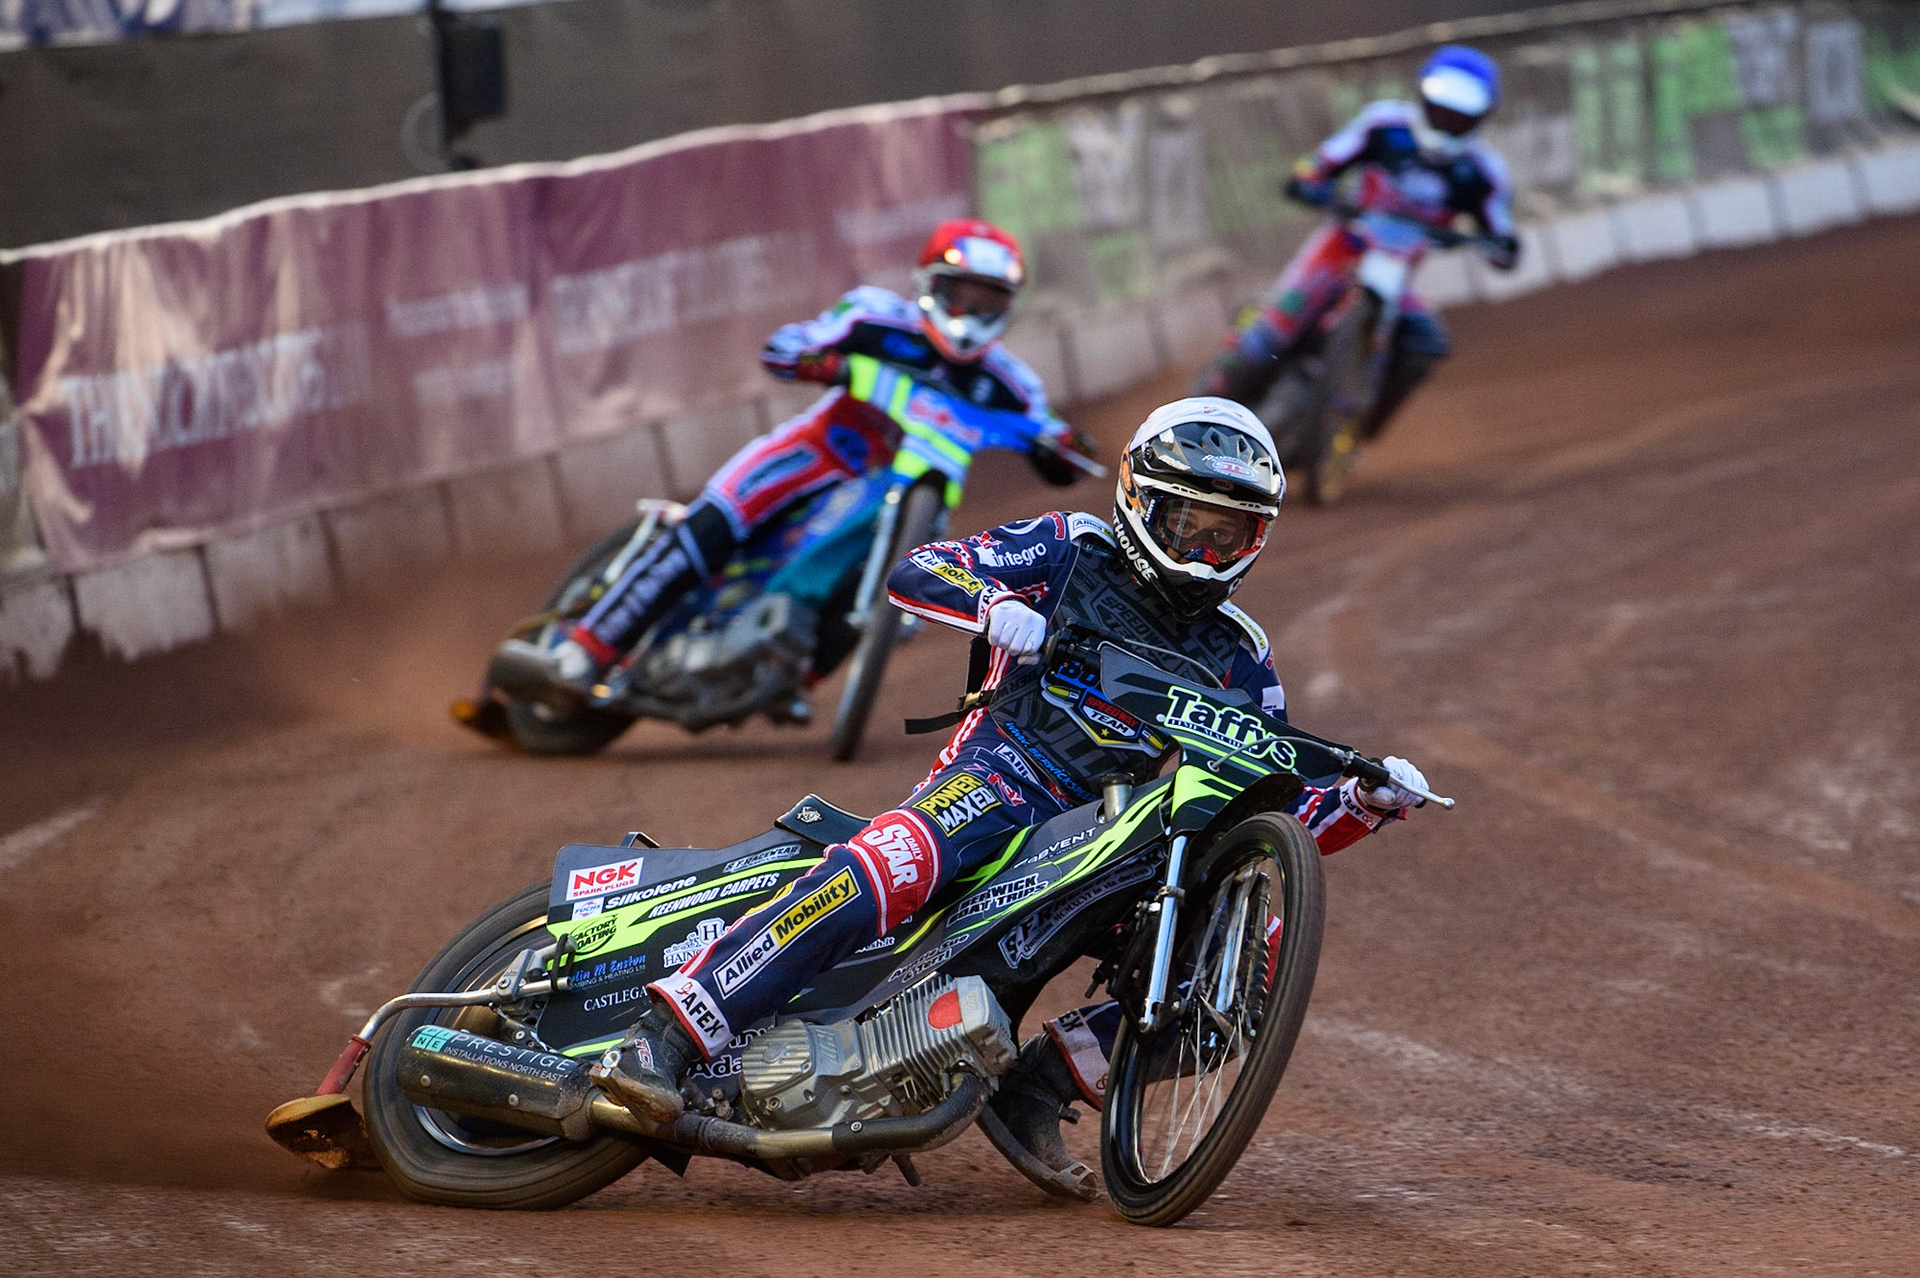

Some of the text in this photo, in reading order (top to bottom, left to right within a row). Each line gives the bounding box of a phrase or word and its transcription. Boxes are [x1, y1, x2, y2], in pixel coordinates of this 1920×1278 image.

[993, 543, 1046, 566] integro
[1085, 696, 1139, 726] SPEEDWAY
[1089, 710, 1129, 732] TEAM
[920, 774, 984, 815] POWER
[936, 785, 997, 832] MAXED
[862, 823, 919, 889] STAR
[904, 836, 924, 861] DAILY
[573, 862, 638, 889] NGK
[573, 880, 635, 897] SPARK PLUGS
[605, 875, 698, 909] Silkolene
[648, 872, 780, 918] KEENWOOD CARPETS
[959, 874, 1039, 911] BERWICK
[996, 881, 1049, 907] TRIPS
[575, 904, 601, 914] FUCHS
[577, 927, 617, 950] OATING
[724, 881, 851, 985] Allied Mobility
[604, 967, 635, 979] HEATING
[610, 955, 646, 970] Easton
[681, 992, 725, 1038] AFEX
[443, 1046, 564, 1081] INSTALLATIONS NORTH EAST
[451, 1033, 576, 1071] PRESTIGE
